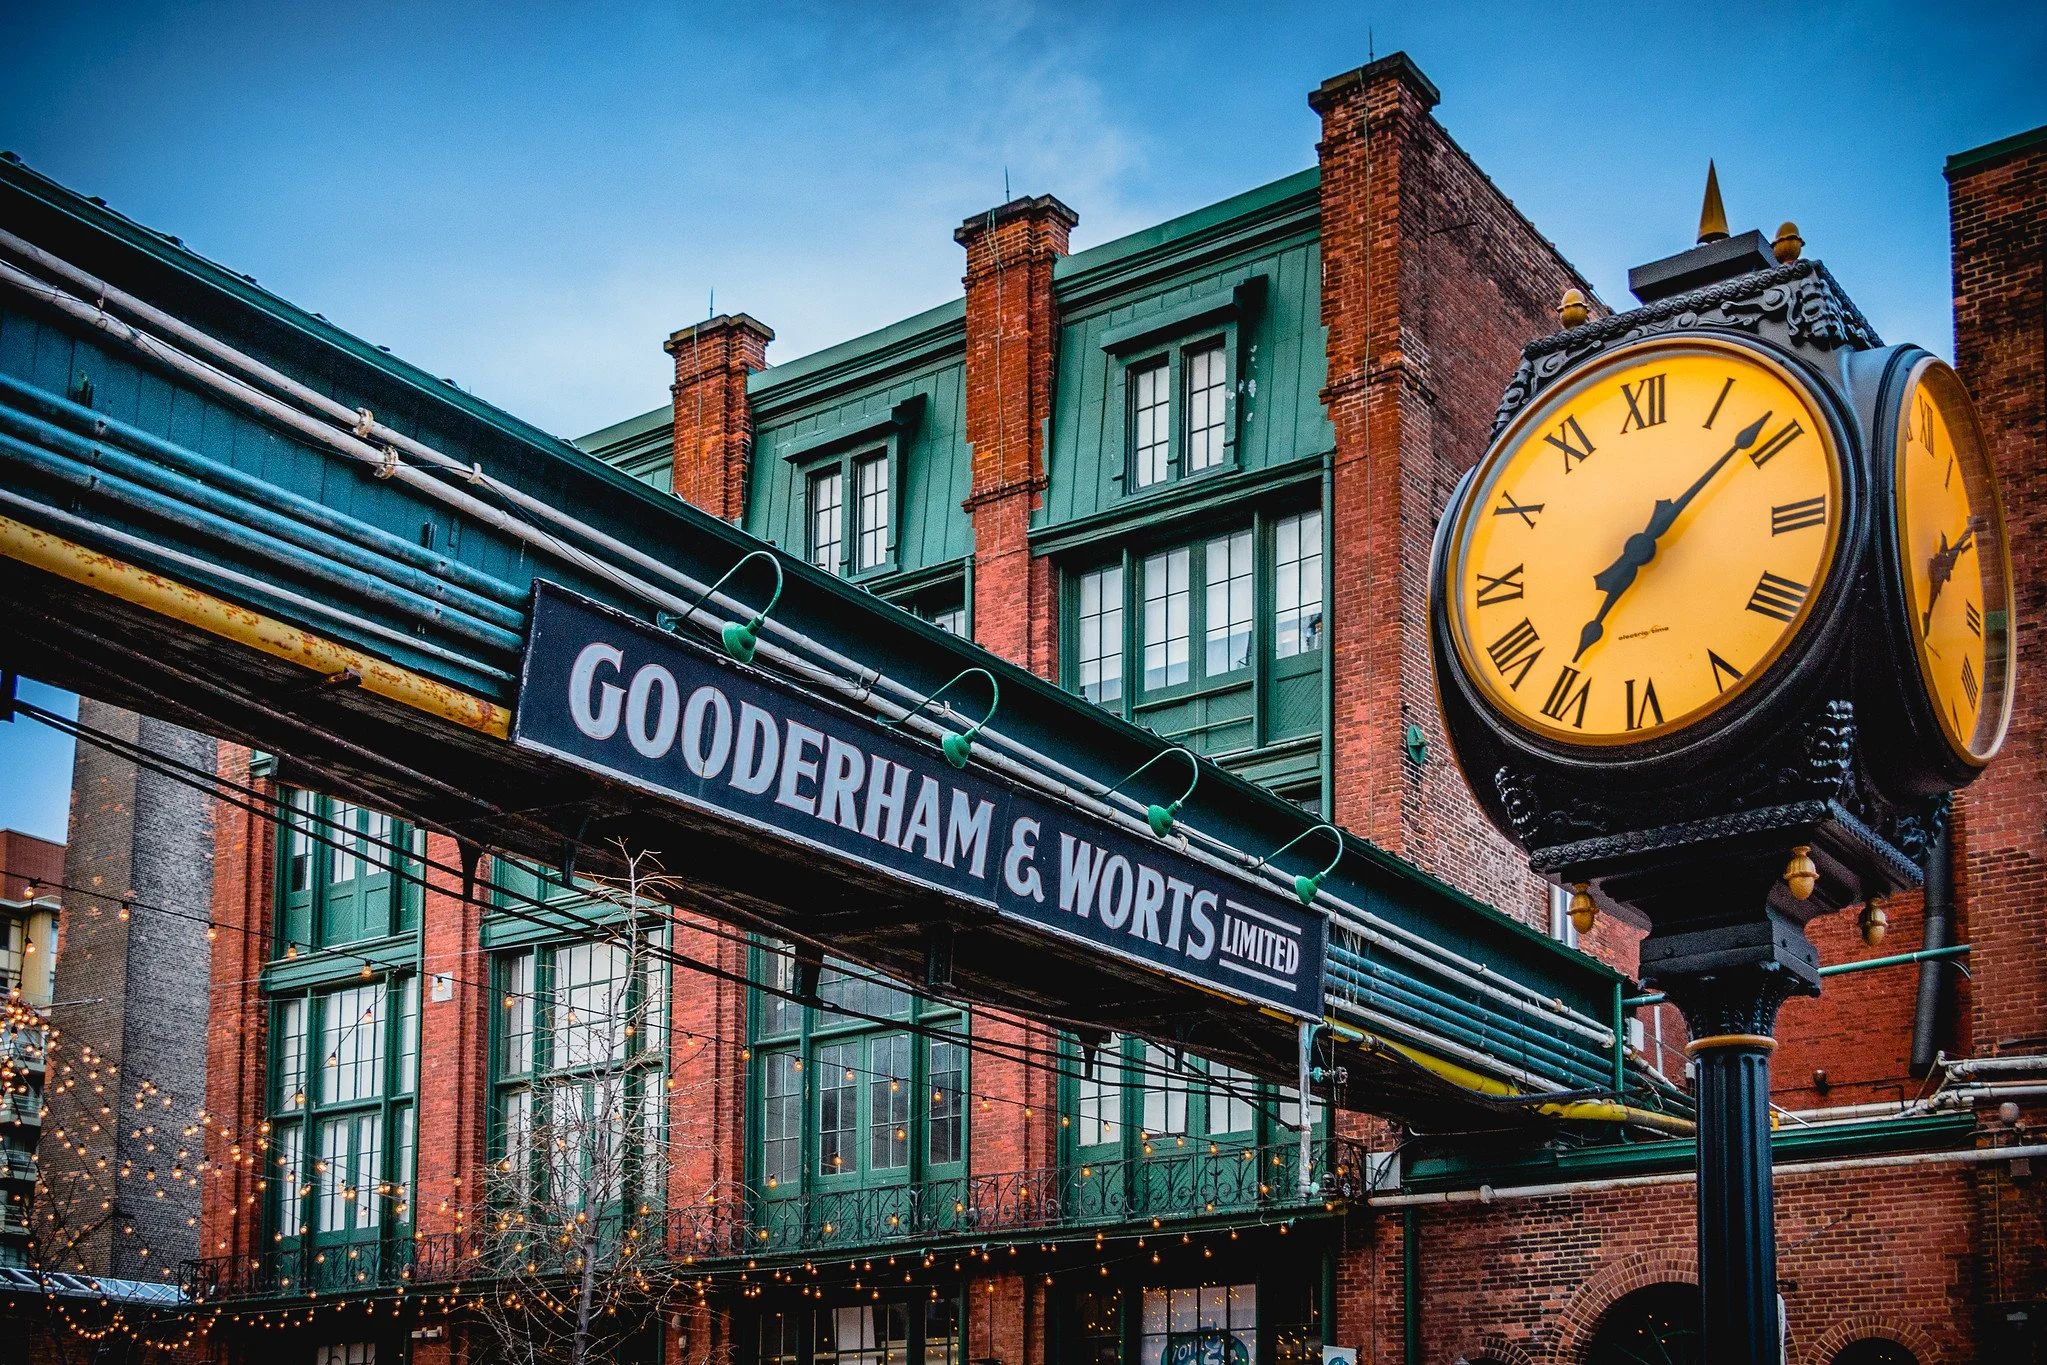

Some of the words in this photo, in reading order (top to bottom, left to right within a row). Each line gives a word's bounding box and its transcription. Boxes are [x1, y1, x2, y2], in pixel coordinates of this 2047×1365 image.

[1621, 374, 1667, 434] XII
[1703, 378, 1735, 430] I
[1543, 415, 1597, 474] XI
[1749, 419, 1804, 469] II
[1494, 490, 1545, 529] X
[1771, 495, 1826, 537] III
[1477, 564, 1524, 608] IX
[1745, 570, 1810, 623] IIII
[1487, 617, 1545, 691] VIII
[1707, 648, 1744, 694] V
[1540, 666, 1593, 729] VII
[1625, 679, 1665, 732] VI
[568, 642, 994, 880] GOODERHAM
[1004, 817, 1045, 903] &
[1059, 831, 1219, 961] WORTS
[1220, 913, 1300, 975] LIMITED
